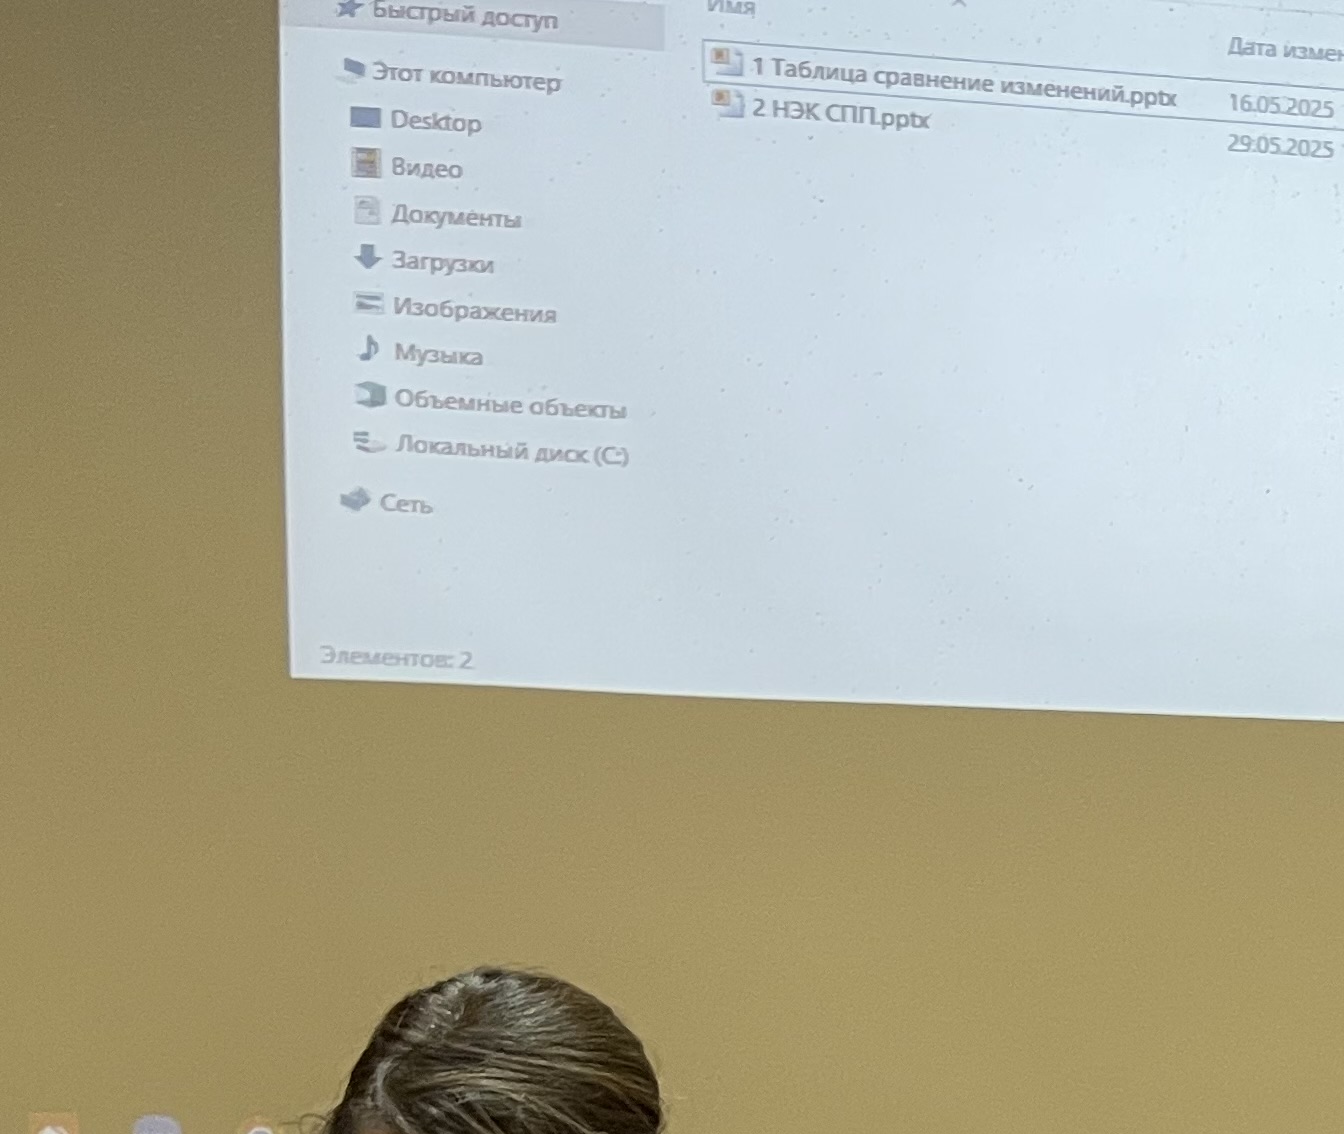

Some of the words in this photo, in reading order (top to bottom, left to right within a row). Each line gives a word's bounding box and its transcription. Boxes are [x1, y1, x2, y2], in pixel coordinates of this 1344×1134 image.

[373, 0, 475, 25] Быстрый
[482, 10, 559, 33] доступ
[708, 0, 757, 15] Имя
[1228, 36, 1277, 57] Дата
[373, 61, 423, 83] Этот
[430, 68, 561, 95] компьютер
[753, 57, 763, 75] 1
[773, 59, 868, 86] Таблица
[873, 68, 994, 94] сравнение
[1000, 80, 1177, 110] изменений.pptx
[752, 98, 766, 117] 2
[772, 101, 820, 122] НЭК
[825, 103, 932, 132] СПП.pptx
[1229, 93, 1334, 119] 16.05.2025
[391, 109, 483, 137] Desktop
[1228, 134, 1334, 159] 29.05.2025
[392, 158, 463, 182] Видео
[392, 204, 522, 231] Документы
[392, 250, 495, 277] Загрузки
[394, 297, 557, 325] Изображения
[394, 343, 484, 368] Музыка
[395, 388, 524, 415] Объемные
[529, 398, 628, 420] объекты
[396, 433, 530, 461] Локальный
[535, 446, 589, 465] диск
[380, 493, 433, 515] Сеть
[320, 644, 454, 670] Элементов:
[459, 650, 474, 670] 2
